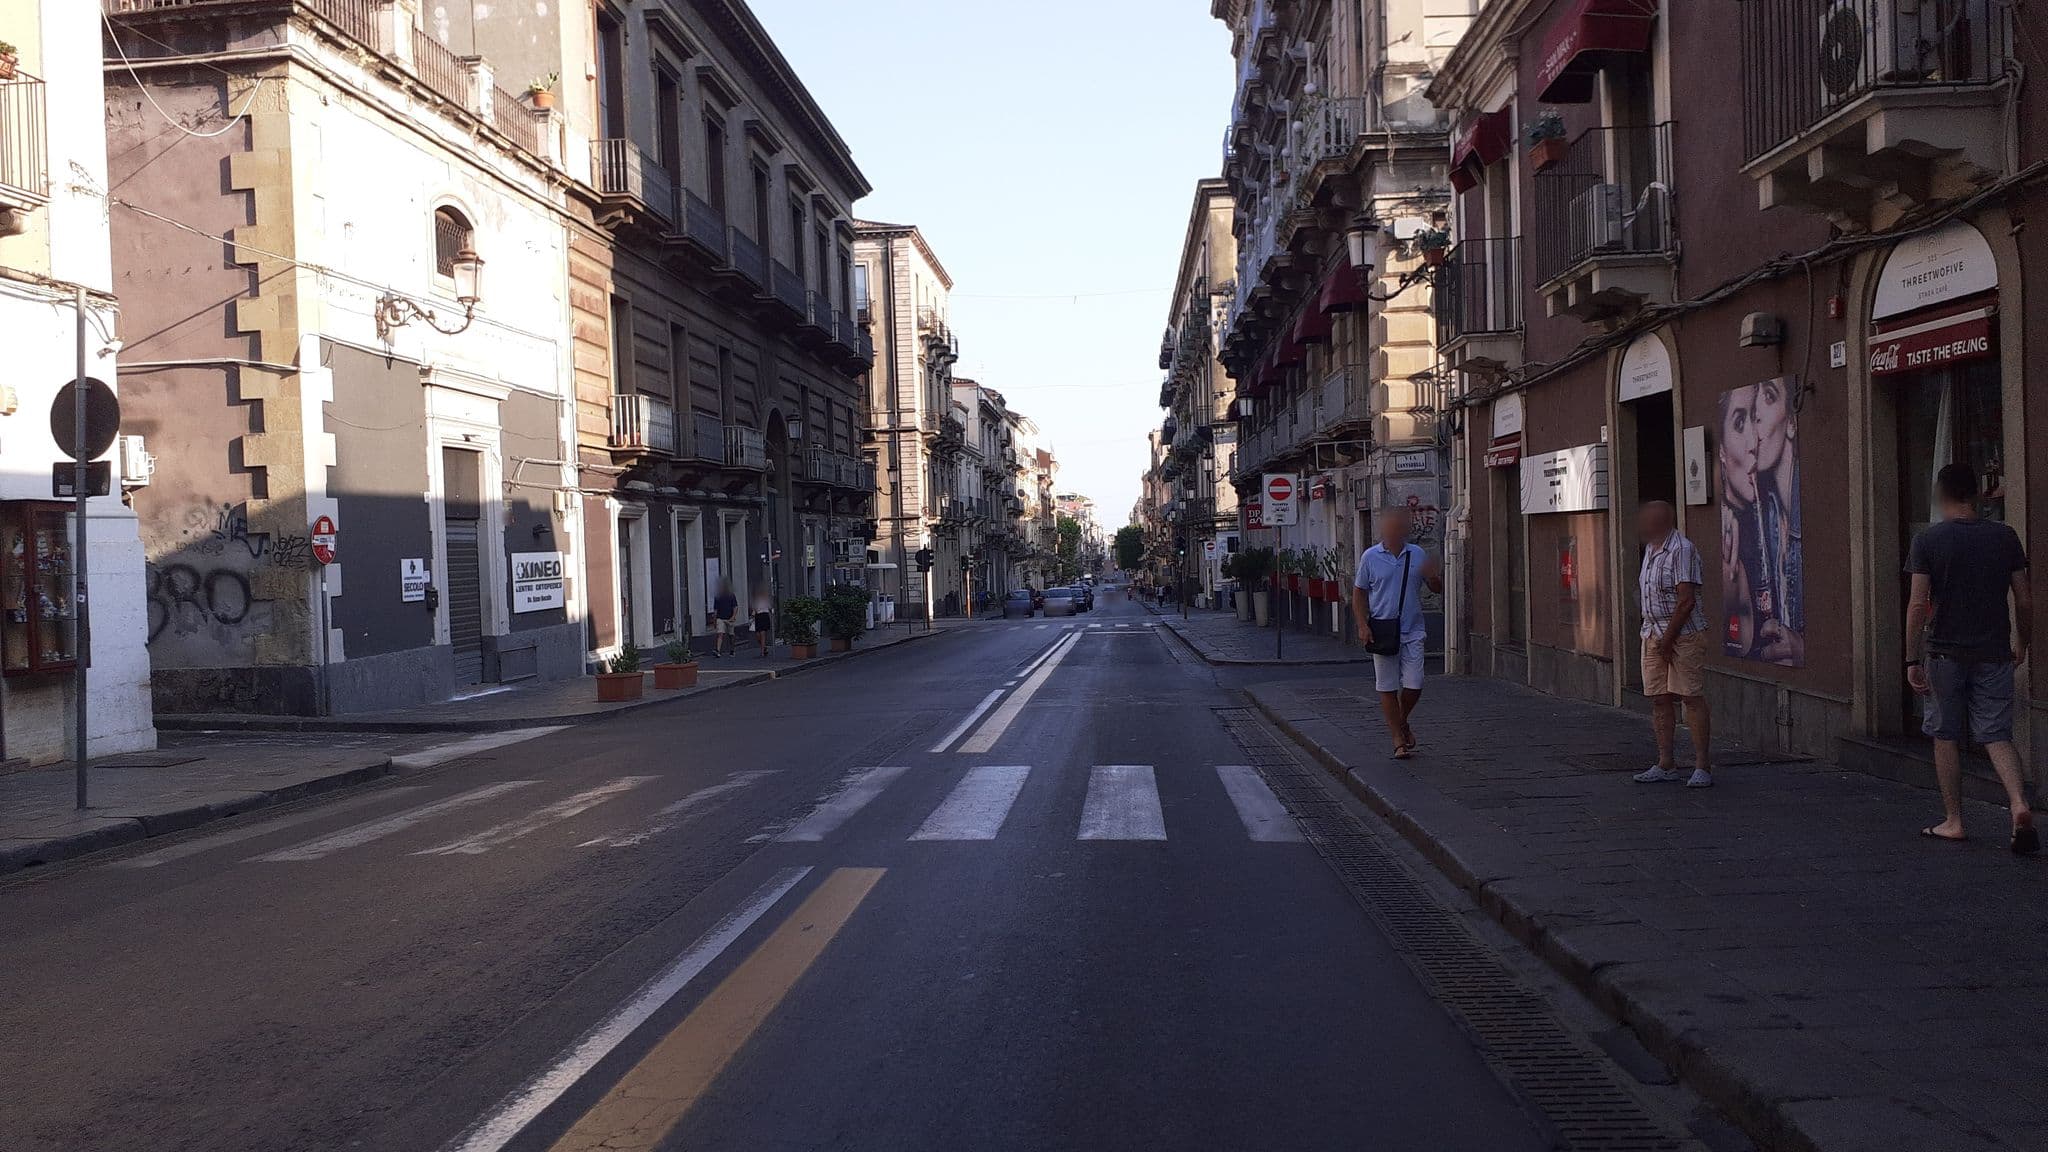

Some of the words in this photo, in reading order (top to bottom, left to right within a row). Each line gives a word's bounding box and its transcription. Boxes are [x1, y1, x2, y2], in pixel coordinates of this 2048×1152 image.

[1901, 261, 1964, 289] THREETWOFIVE
[1906, 348, 1931, 367] TASTE
[1932, 344, 1952, 361] THE
